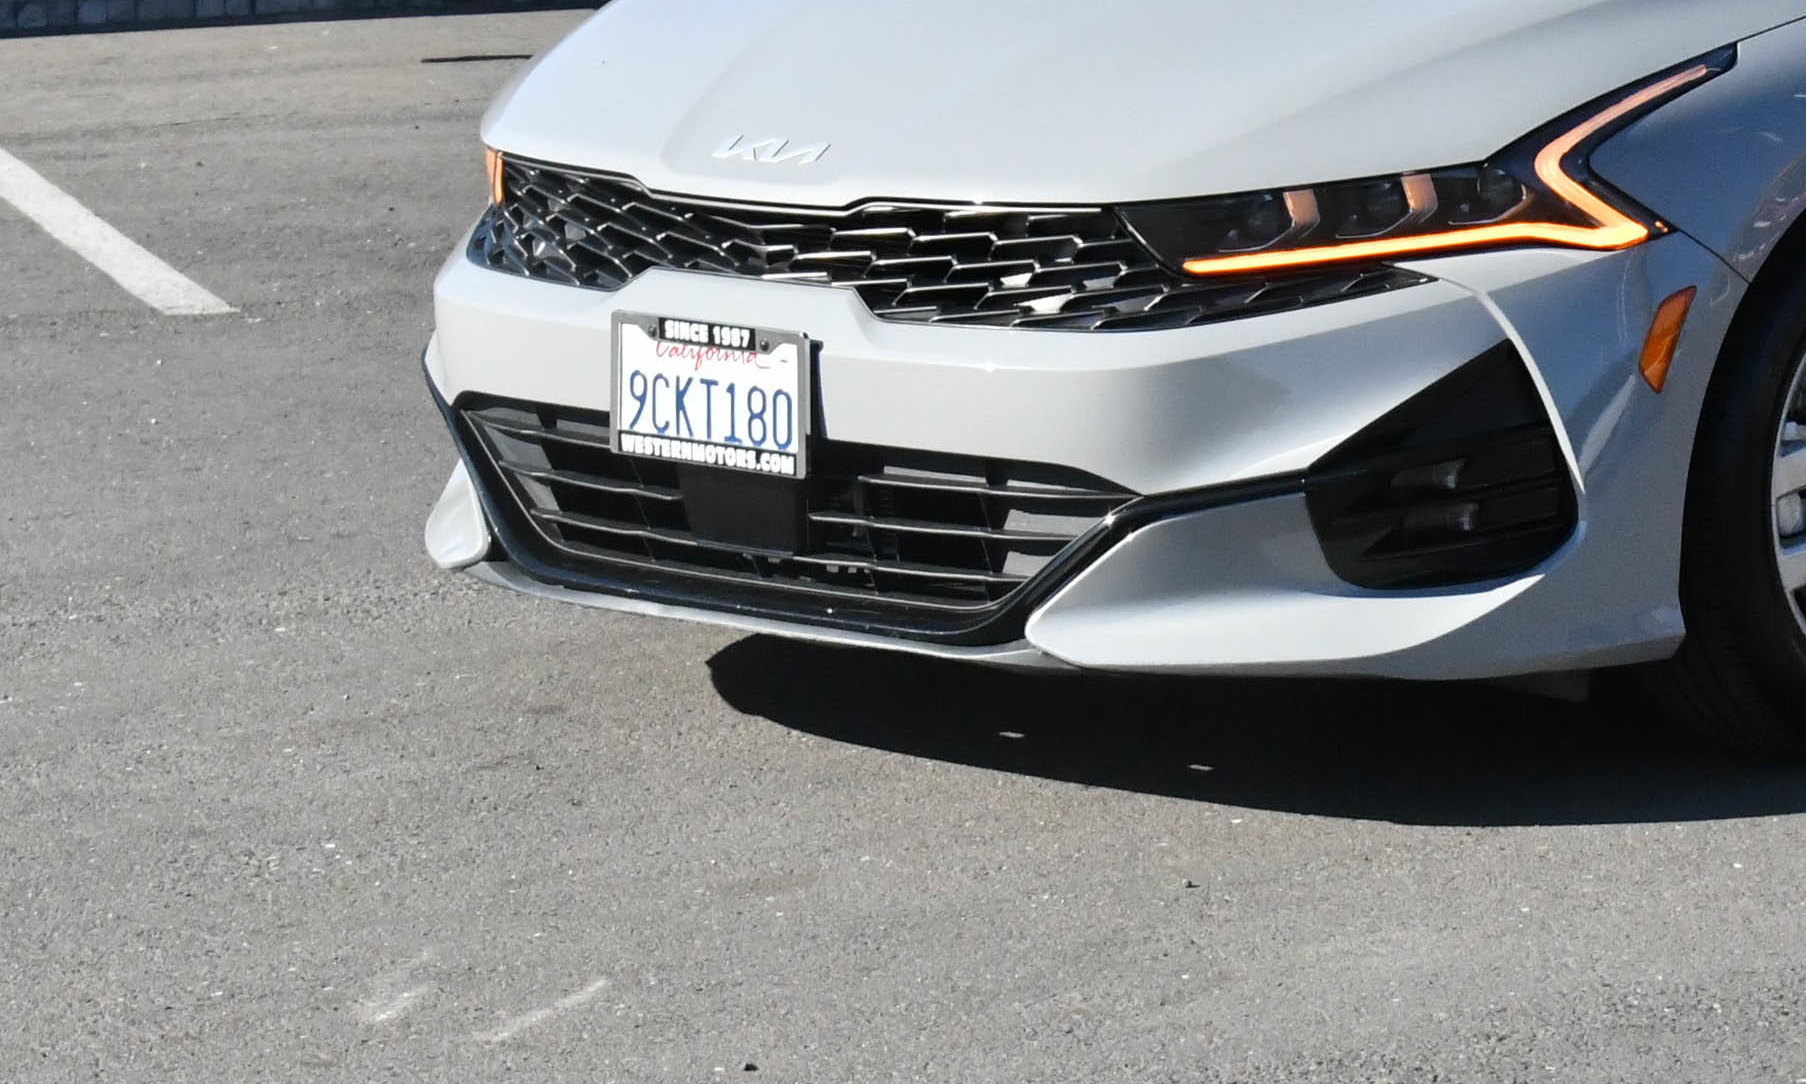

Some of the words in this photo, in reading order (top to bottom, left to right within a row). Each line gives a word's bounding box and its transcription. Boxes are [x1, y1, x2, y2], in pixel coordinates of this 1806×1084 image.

[664, 319, 709, 343] SINCE
[712, 326, 750, 348] 1987
[629, 369, 793, 450] 9CKT180
[620, 432, 795, 476] WESTERNMOTORS.COM
